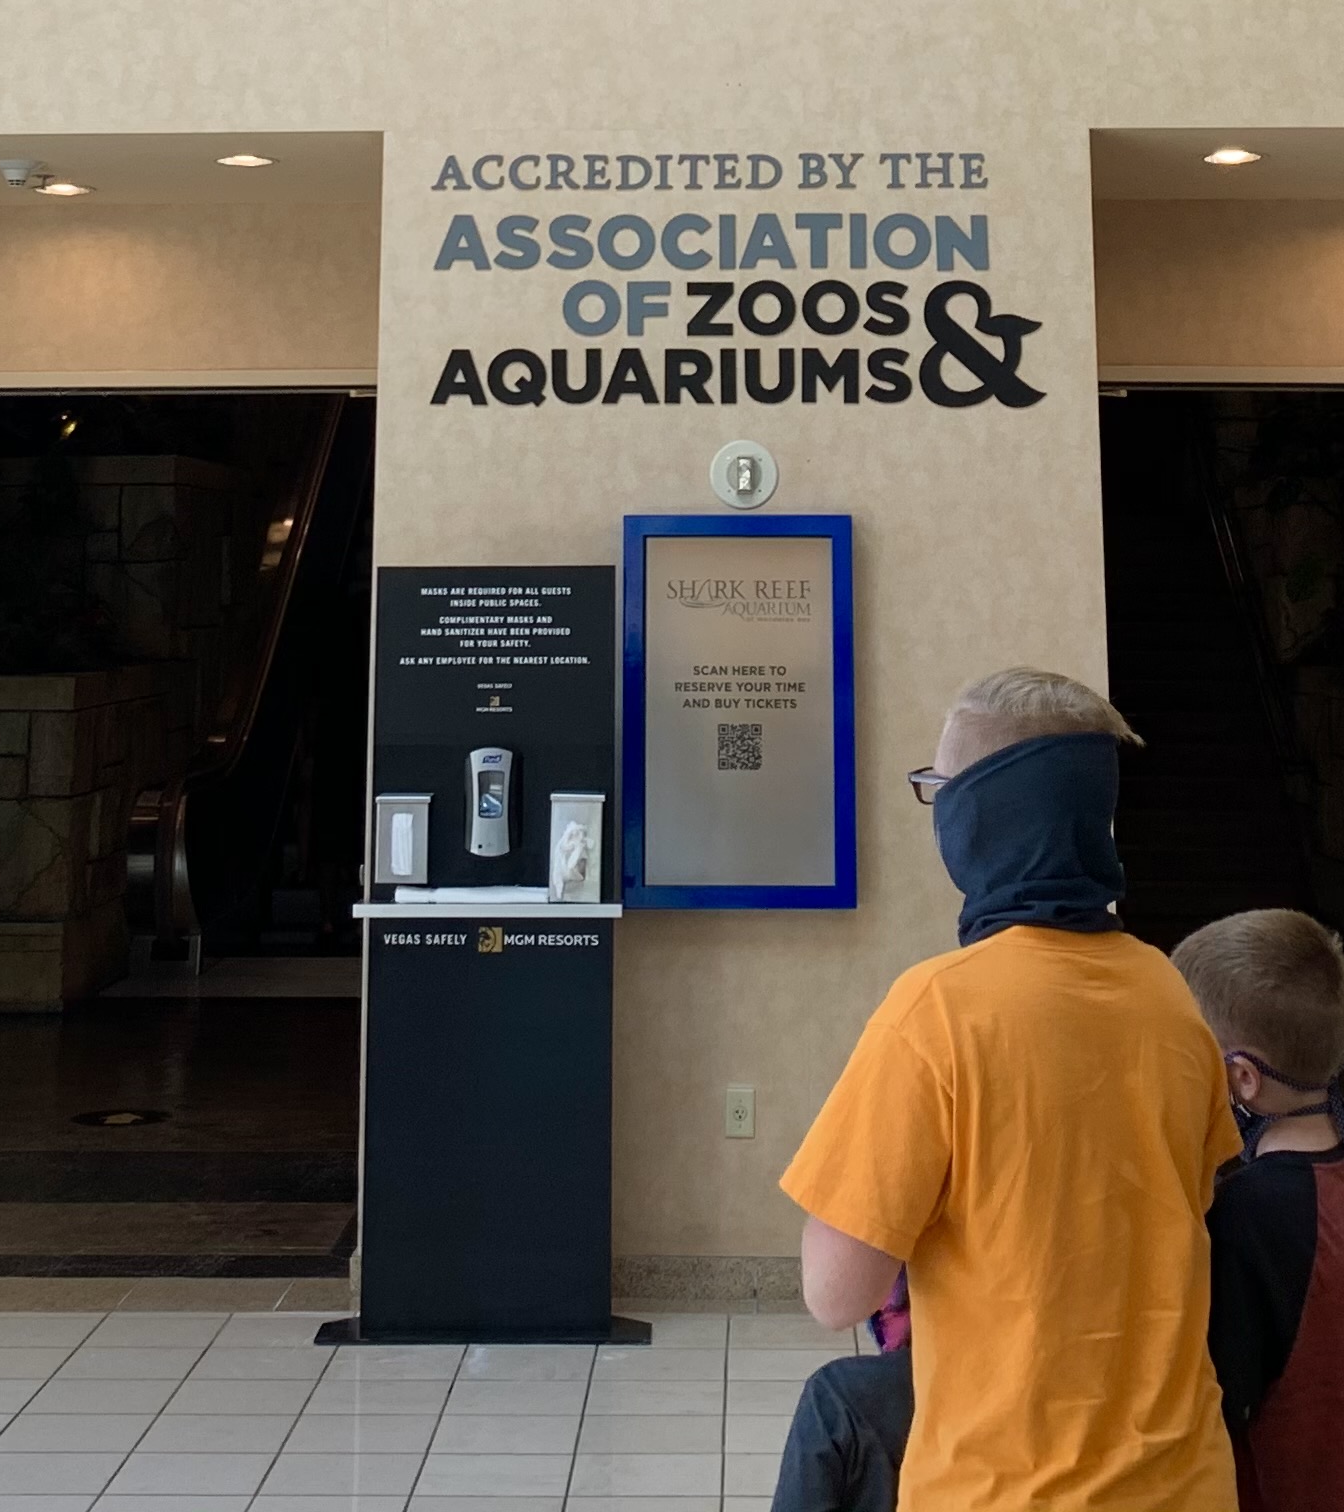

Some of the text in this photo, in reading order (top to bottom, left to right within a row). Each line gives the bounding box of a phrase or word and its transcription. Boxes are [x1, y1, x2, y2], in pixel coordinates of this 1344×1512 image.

[430, 151, 989, 191] ACCREDITED BY THE
[433, 212, 991, 272] ASSOCIATION
[562, 279, 1048, 409] OF ZOOS &
[429, 347, 913, 408] AQUARIUMS
[420, 587, 572, 596] MASKS ARE REQUIRED FOR ALL GUESTS
[667, 578, 812, 600] SHARK REEF
[449, 598, 477, 608] INSIDE
[479, 598, 507, 608] PUBLIC
[722, 601, 812, 619] AQUARIUM
[439, 615, 553, 624] COMPLIMENTARY MASKS AND
[420, 627, 571, 637] HAND SANITIZER HAVE BEEN PROVIDED
[459, 639, 475, 648] FOR
[476, 639, 498, 648] YOUR
[399, 656, 416, 665] ASK
[417, 656, 434, 665] ANY
[436, 656, 476, 665] EMPLOYEE
[478, 656, 494, 665] FOR
[496, 656, 511, 665] THE
[513, 656, 549, 665] NEAREST
[693, 665, 787, 677] SCAN HERE TO
[674, 681, 806, 693] RESERVE YOUR TIME
[682, 698, 798, 710] AND BUY TICKETS
[383, 933, 468, 946] VEGAS SAFELY
[503, 934, 600, 947] MGM RESORTS
